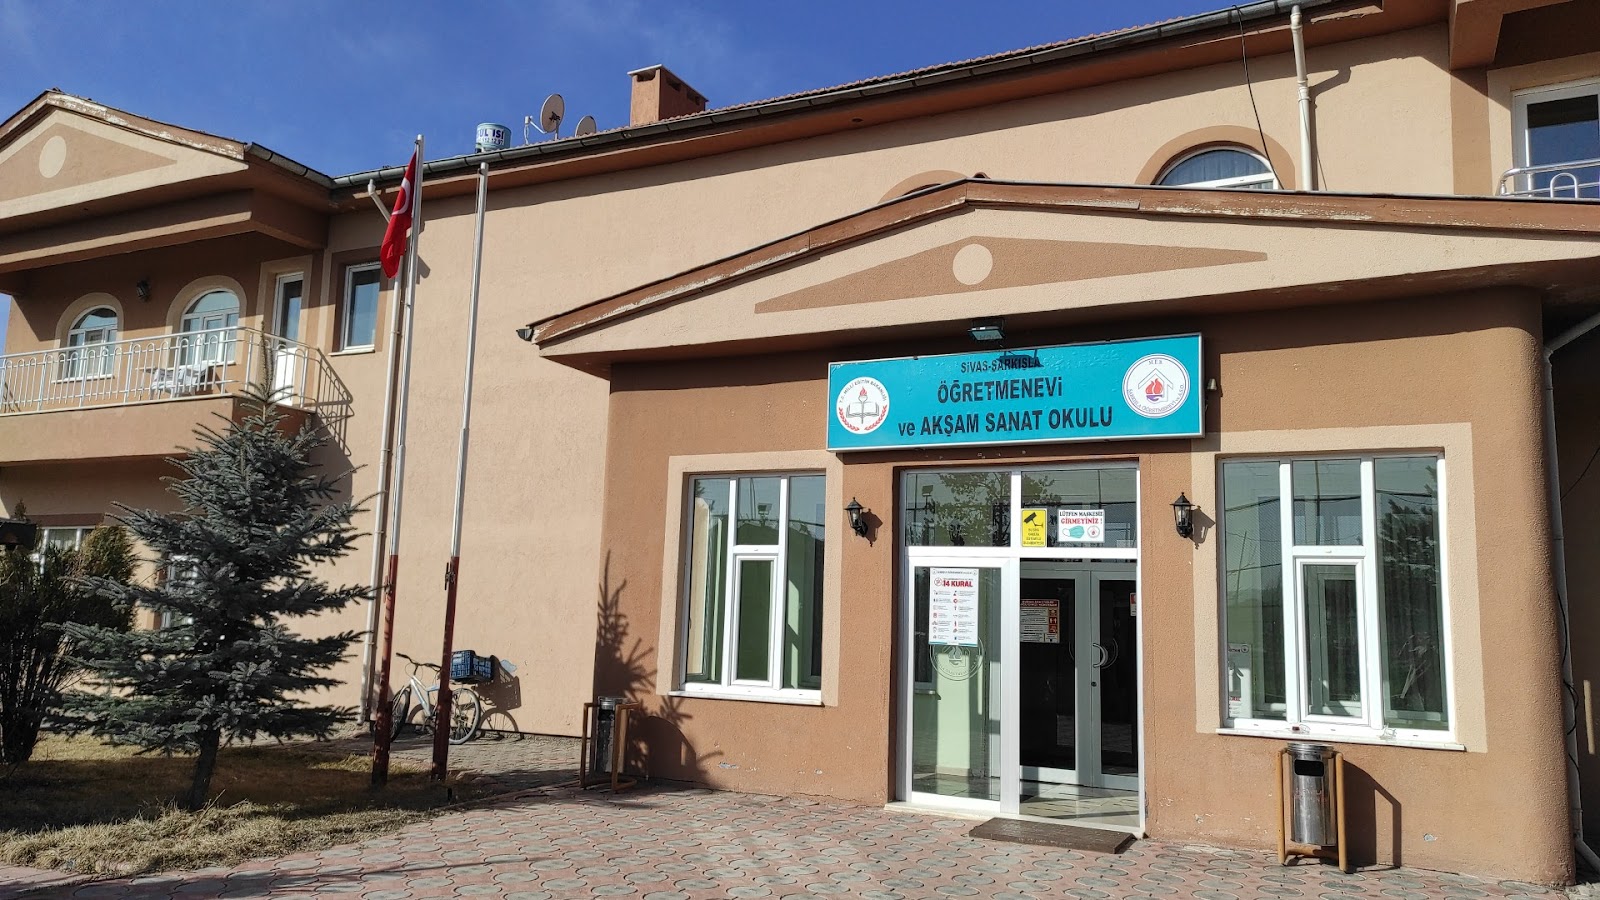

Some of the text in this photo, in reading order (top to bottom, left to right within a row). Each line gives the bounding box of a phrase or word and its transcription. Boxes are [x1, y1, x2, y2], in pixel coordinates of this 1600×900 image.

[898, 406, 1113, 437] ve AKŞAM SANAT OKULU
